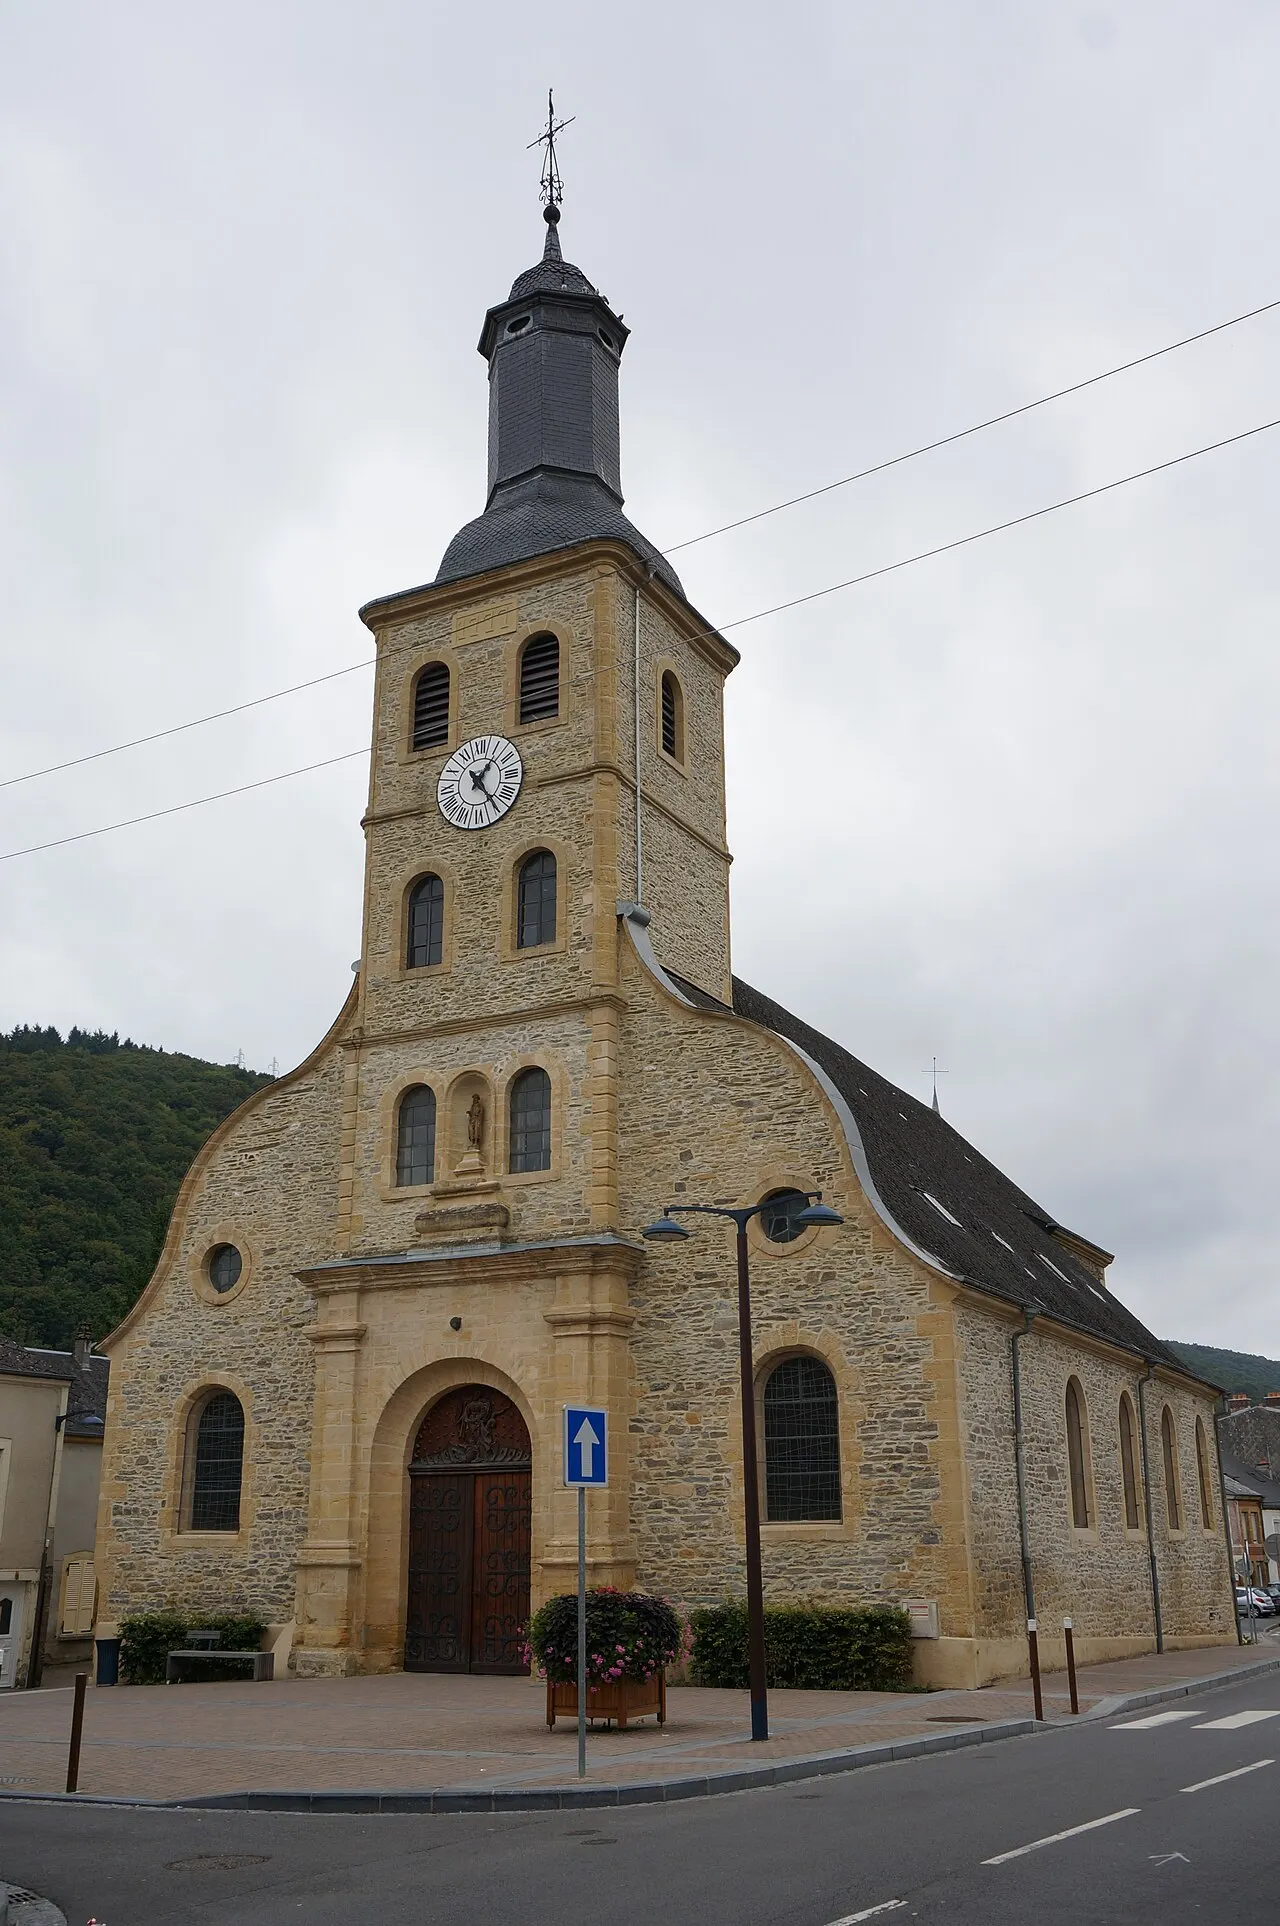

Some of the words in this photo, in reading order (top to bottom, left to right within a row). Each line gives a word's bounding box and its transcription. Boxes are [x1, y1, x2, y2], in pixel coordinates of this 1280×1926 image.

[474, 740, 486, 756] XII
[458, 748, 471, 764] XI
[501, 751, 514, 764] II
[446, 766, 459, 776] X
[504, 769, 518, 779] III
[499, 786, 515, 800] IIII
